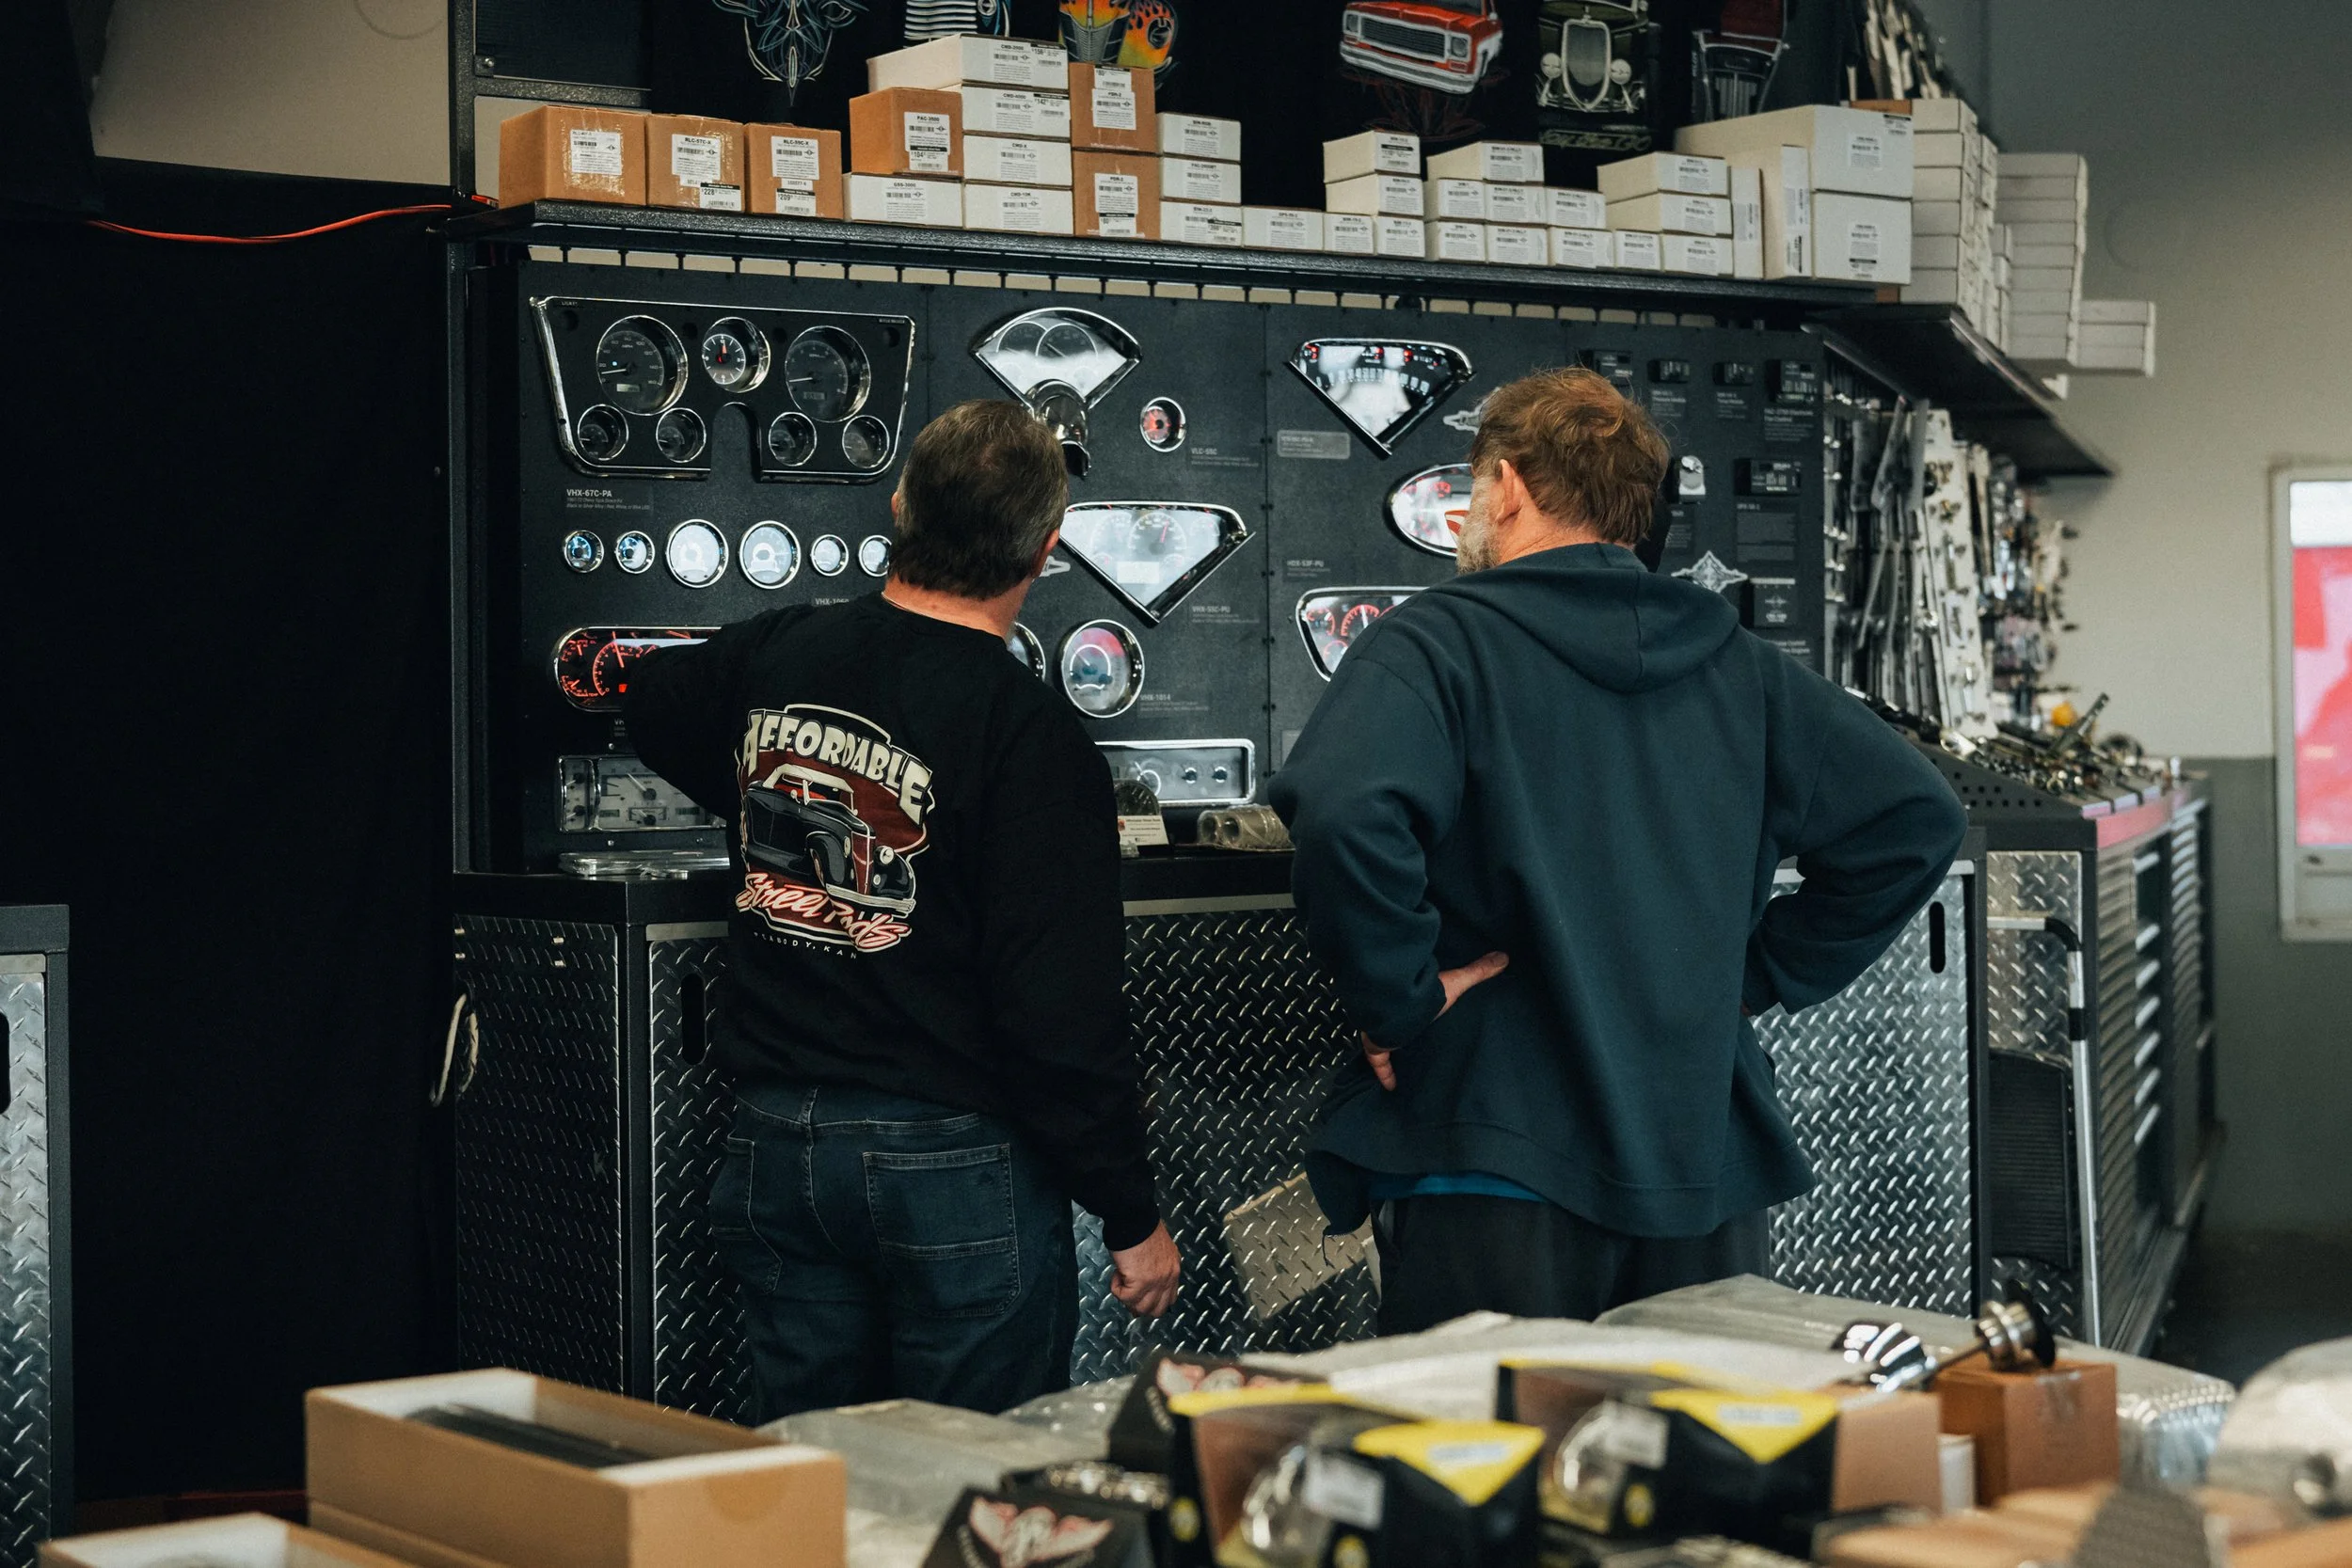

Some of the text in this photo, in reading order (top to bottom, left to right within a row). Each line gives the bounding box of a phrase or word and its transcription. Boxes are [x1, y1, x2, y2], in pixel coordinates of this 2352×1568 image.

[566, 488, 612, 498] VHX-67C-PA
[742, 714, 931, 826] AFFORDABLE
[736, 872, 911, 951] Street Rods
